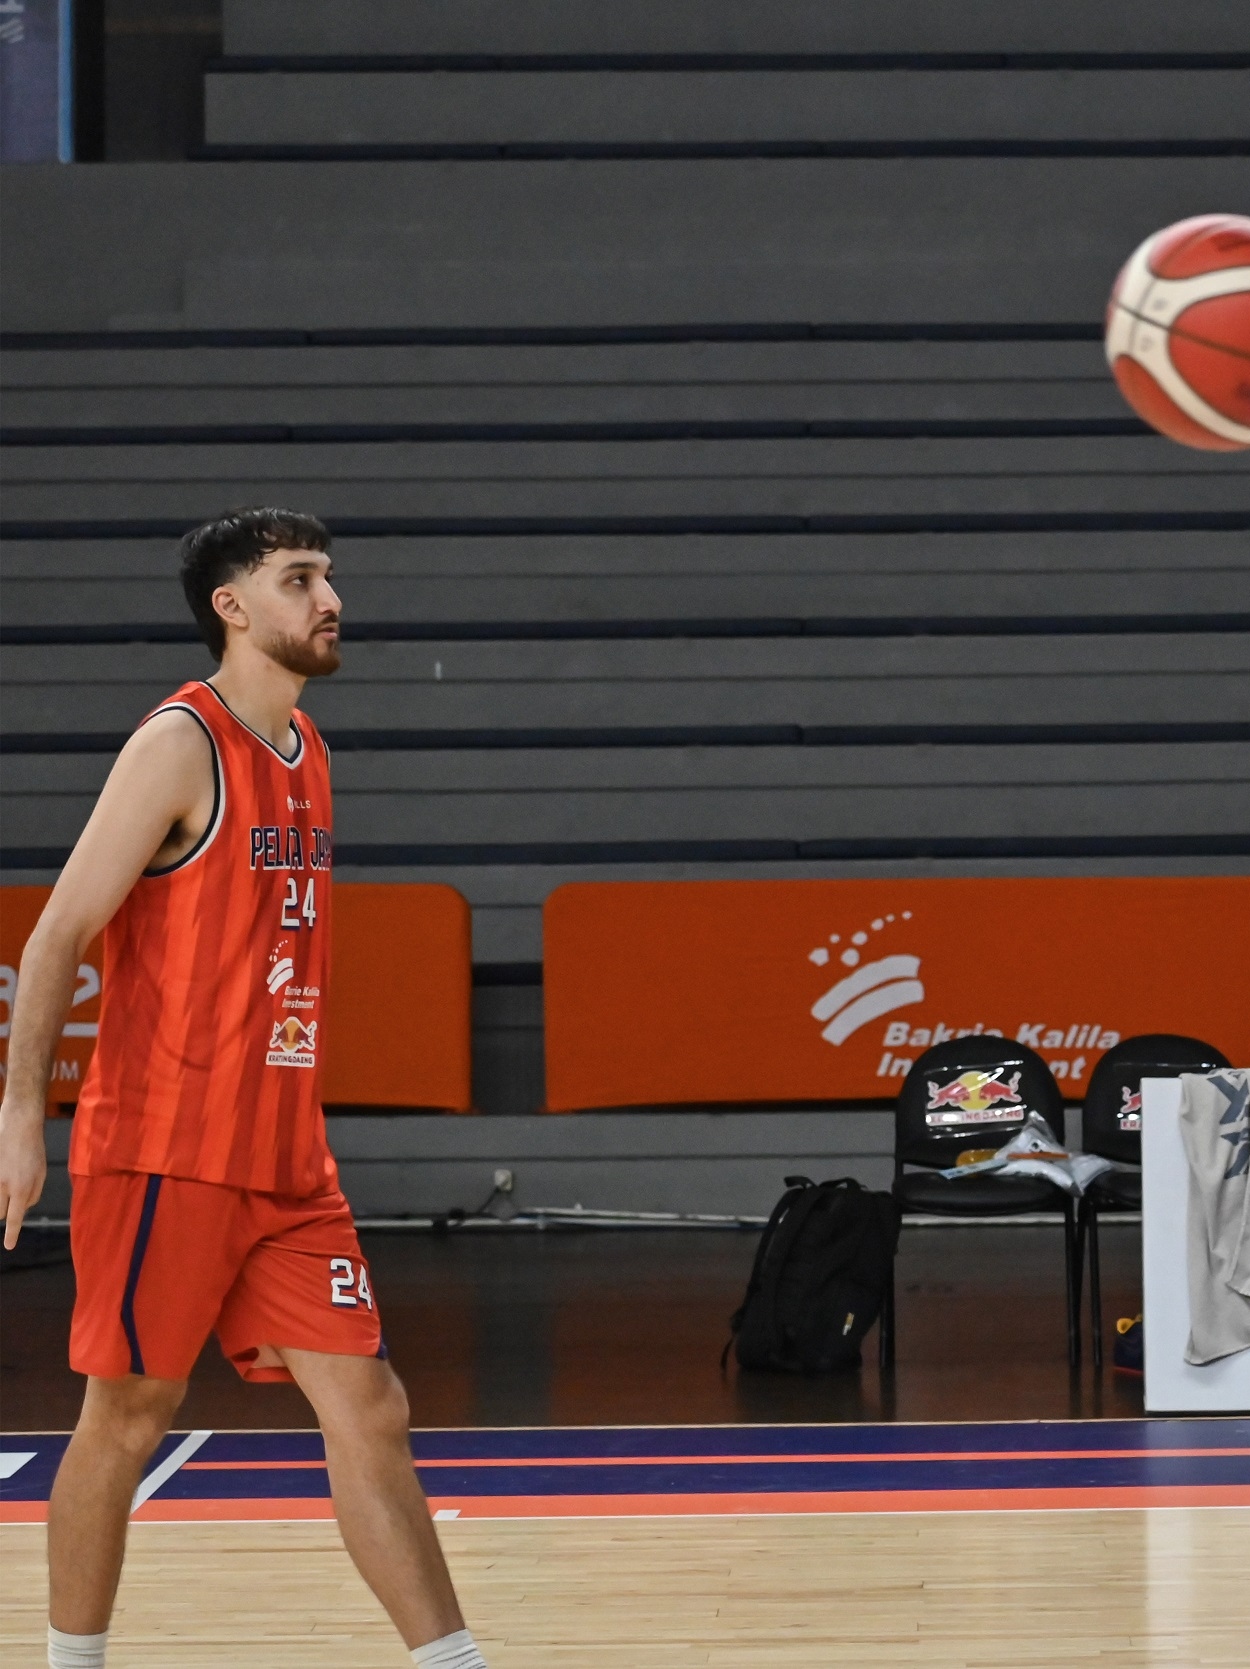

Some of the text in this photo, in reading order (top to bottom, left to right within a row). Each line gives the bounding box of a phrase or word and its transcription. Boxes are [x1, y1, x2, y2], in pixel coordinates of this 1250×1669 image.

[281, 877, 317, 929] 24
[1015, 1022, 1121, 1049] Kalila
[330, 1258, 372, 1309] 24
